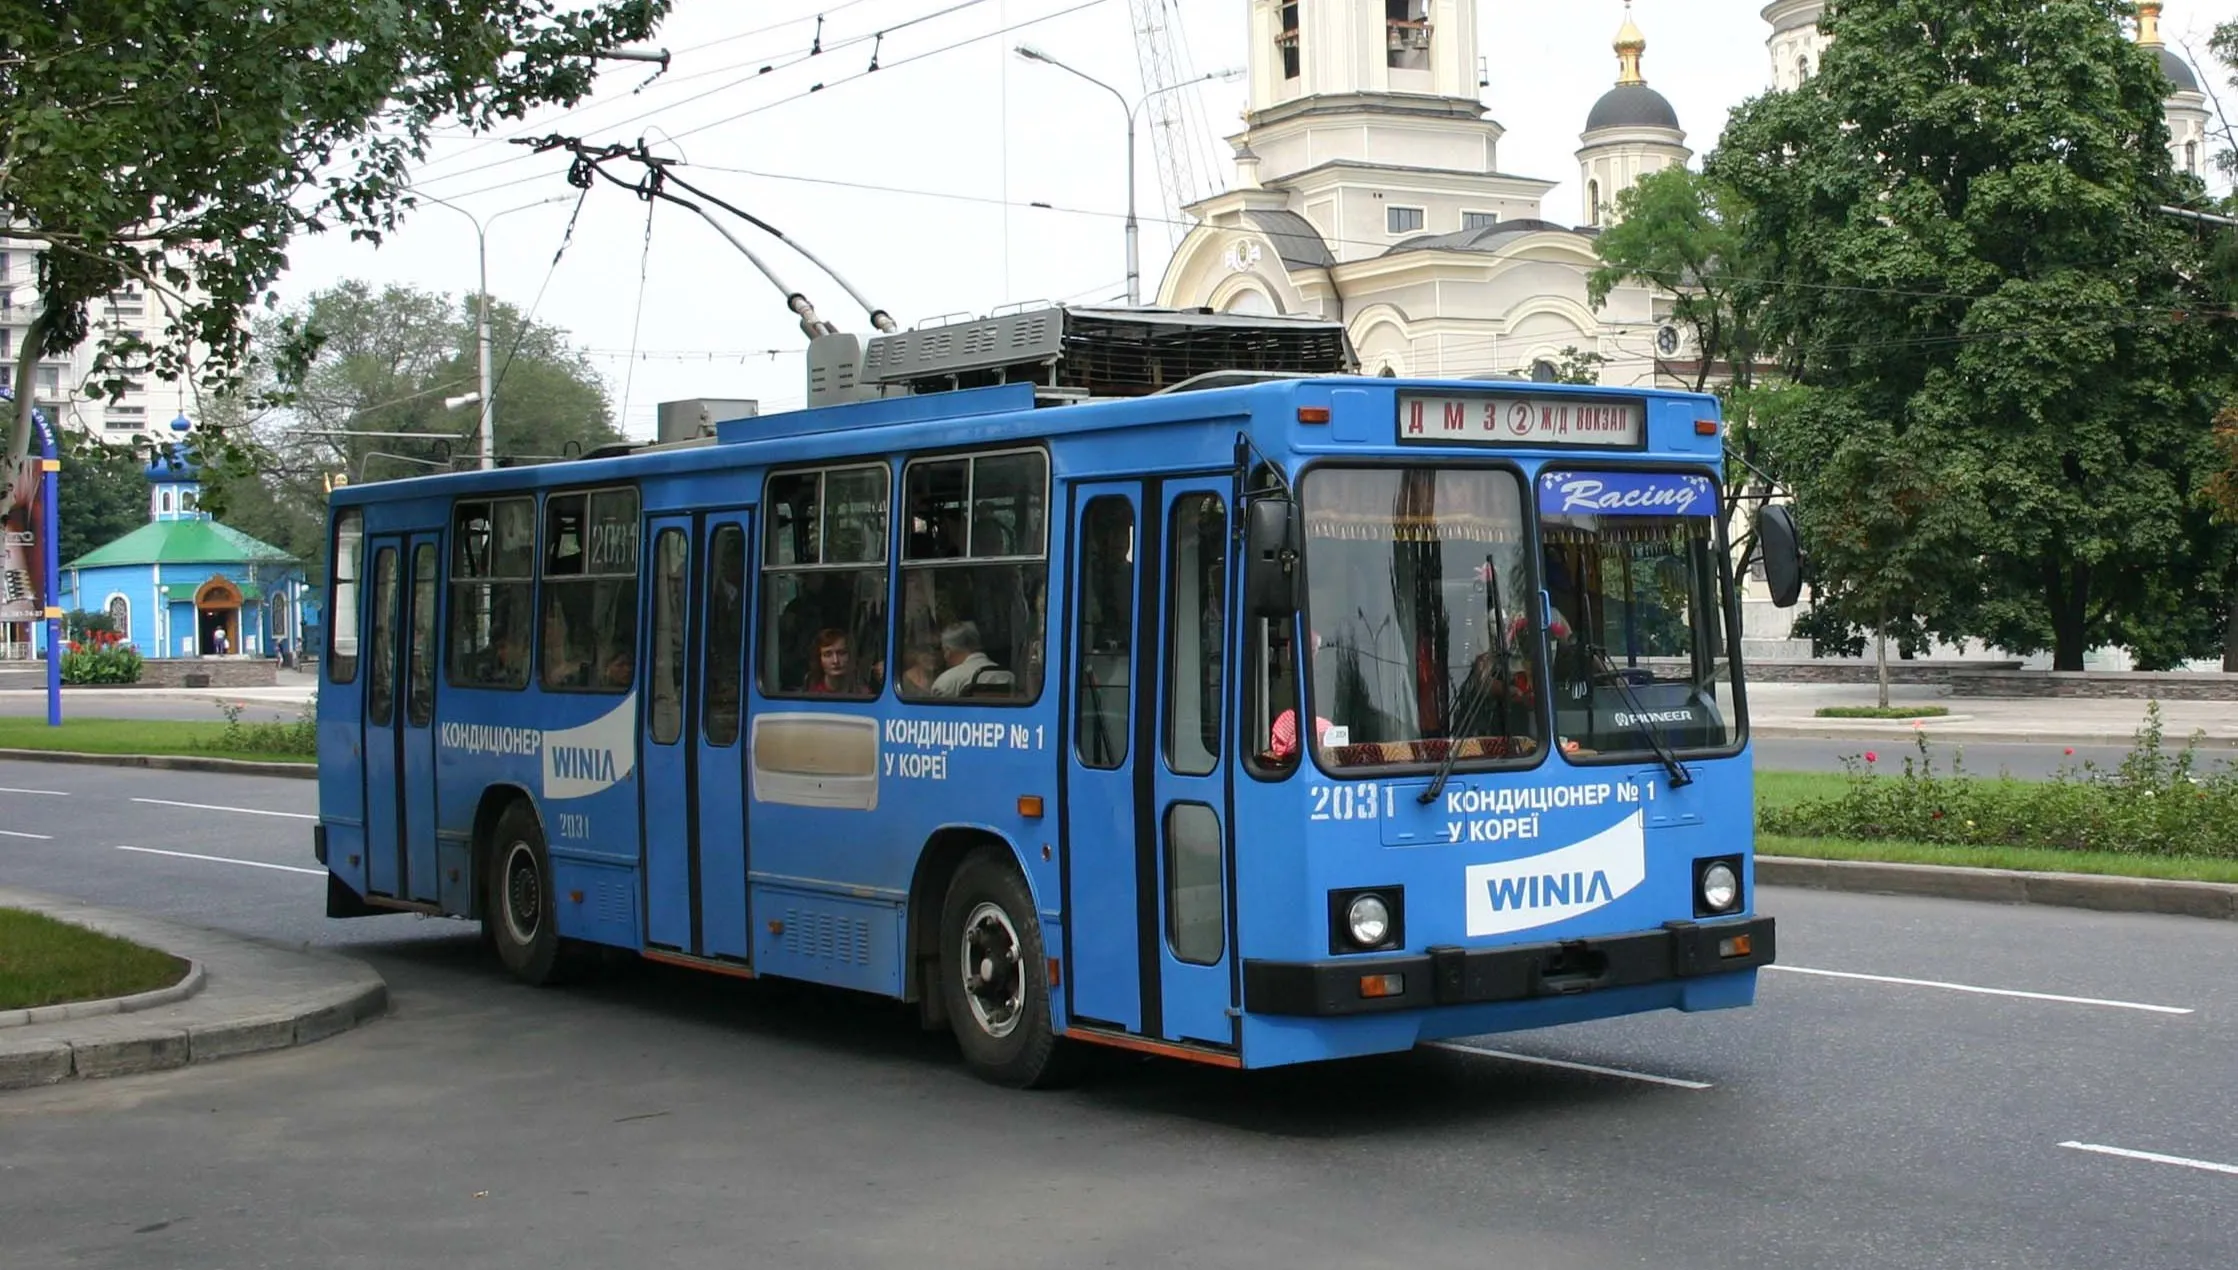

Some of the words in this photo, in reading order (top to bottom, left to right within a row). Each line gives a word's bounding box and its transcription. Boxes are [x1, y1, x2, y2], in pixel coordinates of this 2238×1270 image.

[1515, 406, 1528, 431] 2
[1540, 406, 1568, 436] Ж/Д
[1576, 405, 1627, 432] ВОКЗАЛ
[1560, 479, 1697, 514] Racing
[441, 721, 541, 757] КОНДИЦІОНЕР
[885, 719, 1005, 750] КОНДИЦІОНЕР
[1010, 724, 1029, 749] №
[1036, 724, 1044, 750] 1
[552, 746, 616, 781] WINIA
[884, 752, 895, 777] У
[899, 751, 948, 780] КОРЕЇ
[1310, 783, 1395, 820] 2031
[1447, 783, 1611, 814] КОНДИЦІОНЕР
[1617, 782, 1639, 802] №
[1646, 780, 1656, 800] 1
[559, 813, 590, 839] 2031
[1448, 821, 1462, 842] У
[1470, 812, 1540, 842] КОРЕЇ
[1486, 869, 1613, 912] WINIA
